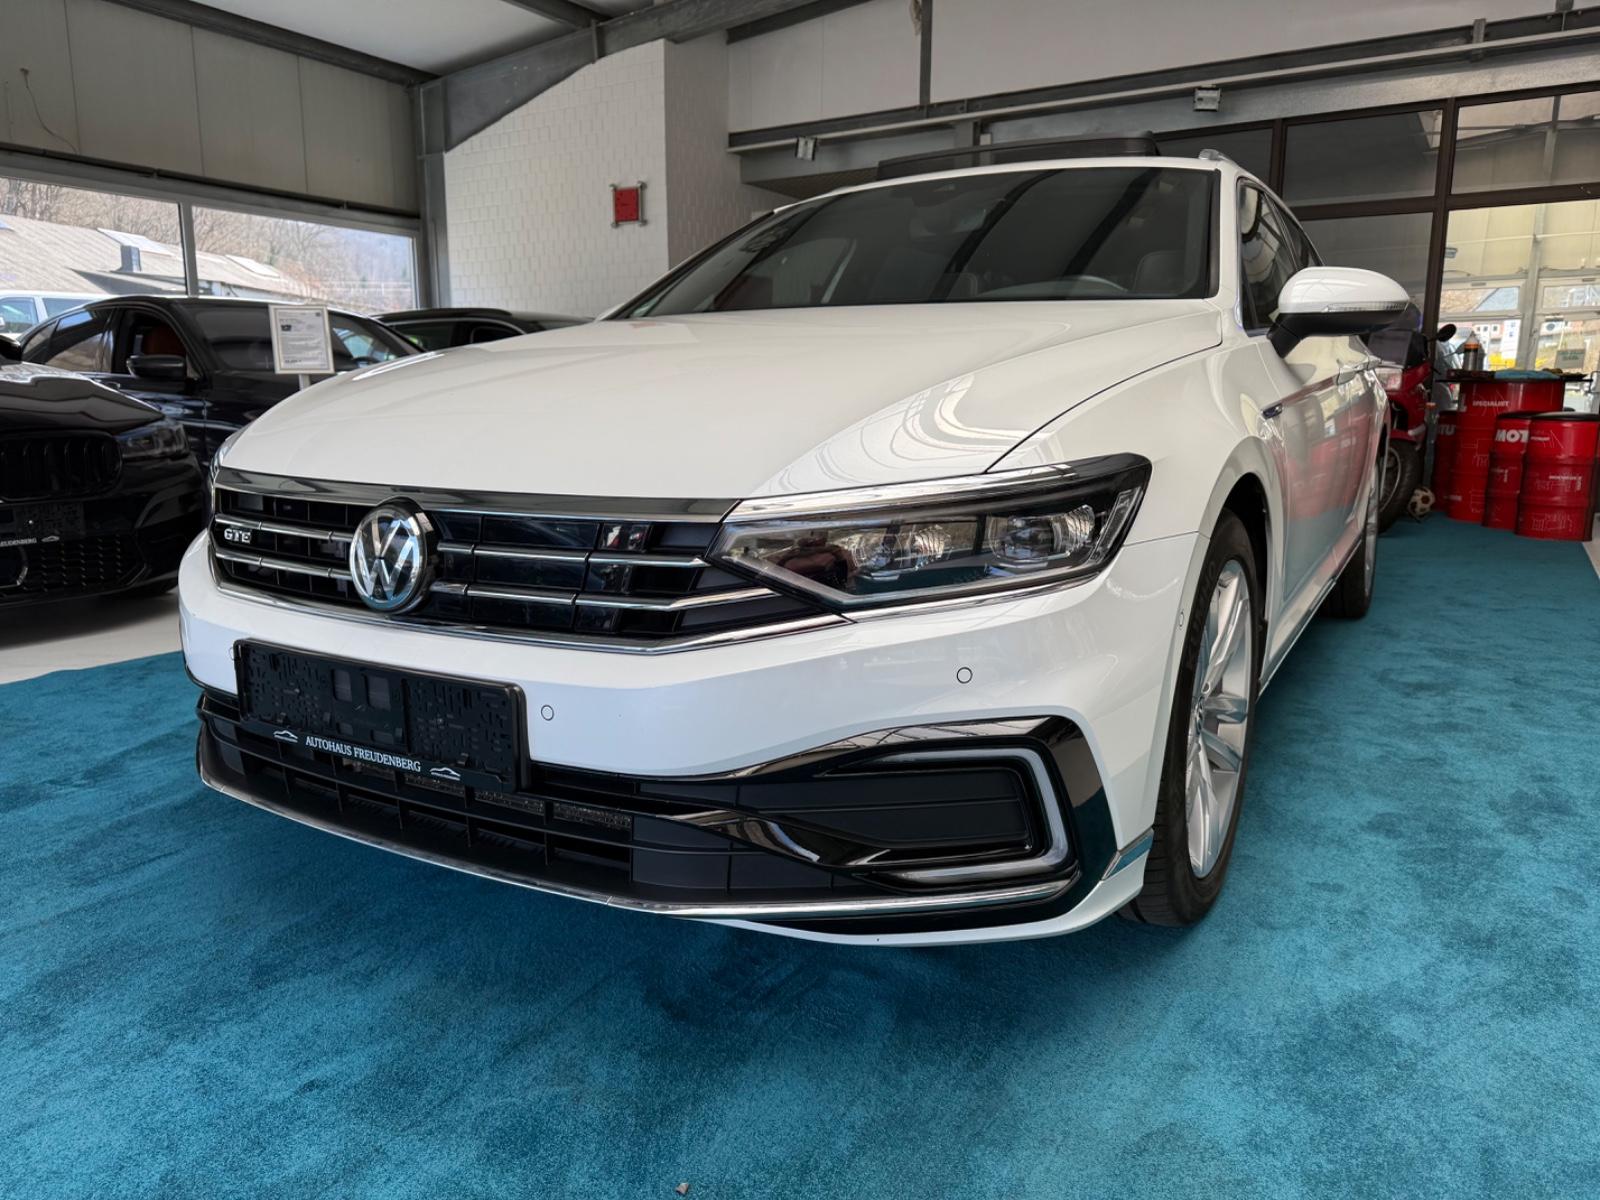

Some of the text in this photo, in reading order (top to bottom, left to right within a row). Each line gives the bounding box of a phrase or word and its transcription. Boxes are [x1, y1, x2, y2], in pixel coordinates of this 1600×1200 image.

[223, 528, 251, 543] GTE
[305, 736, 422, 772] AUTOHAUS FREUDENBERG
